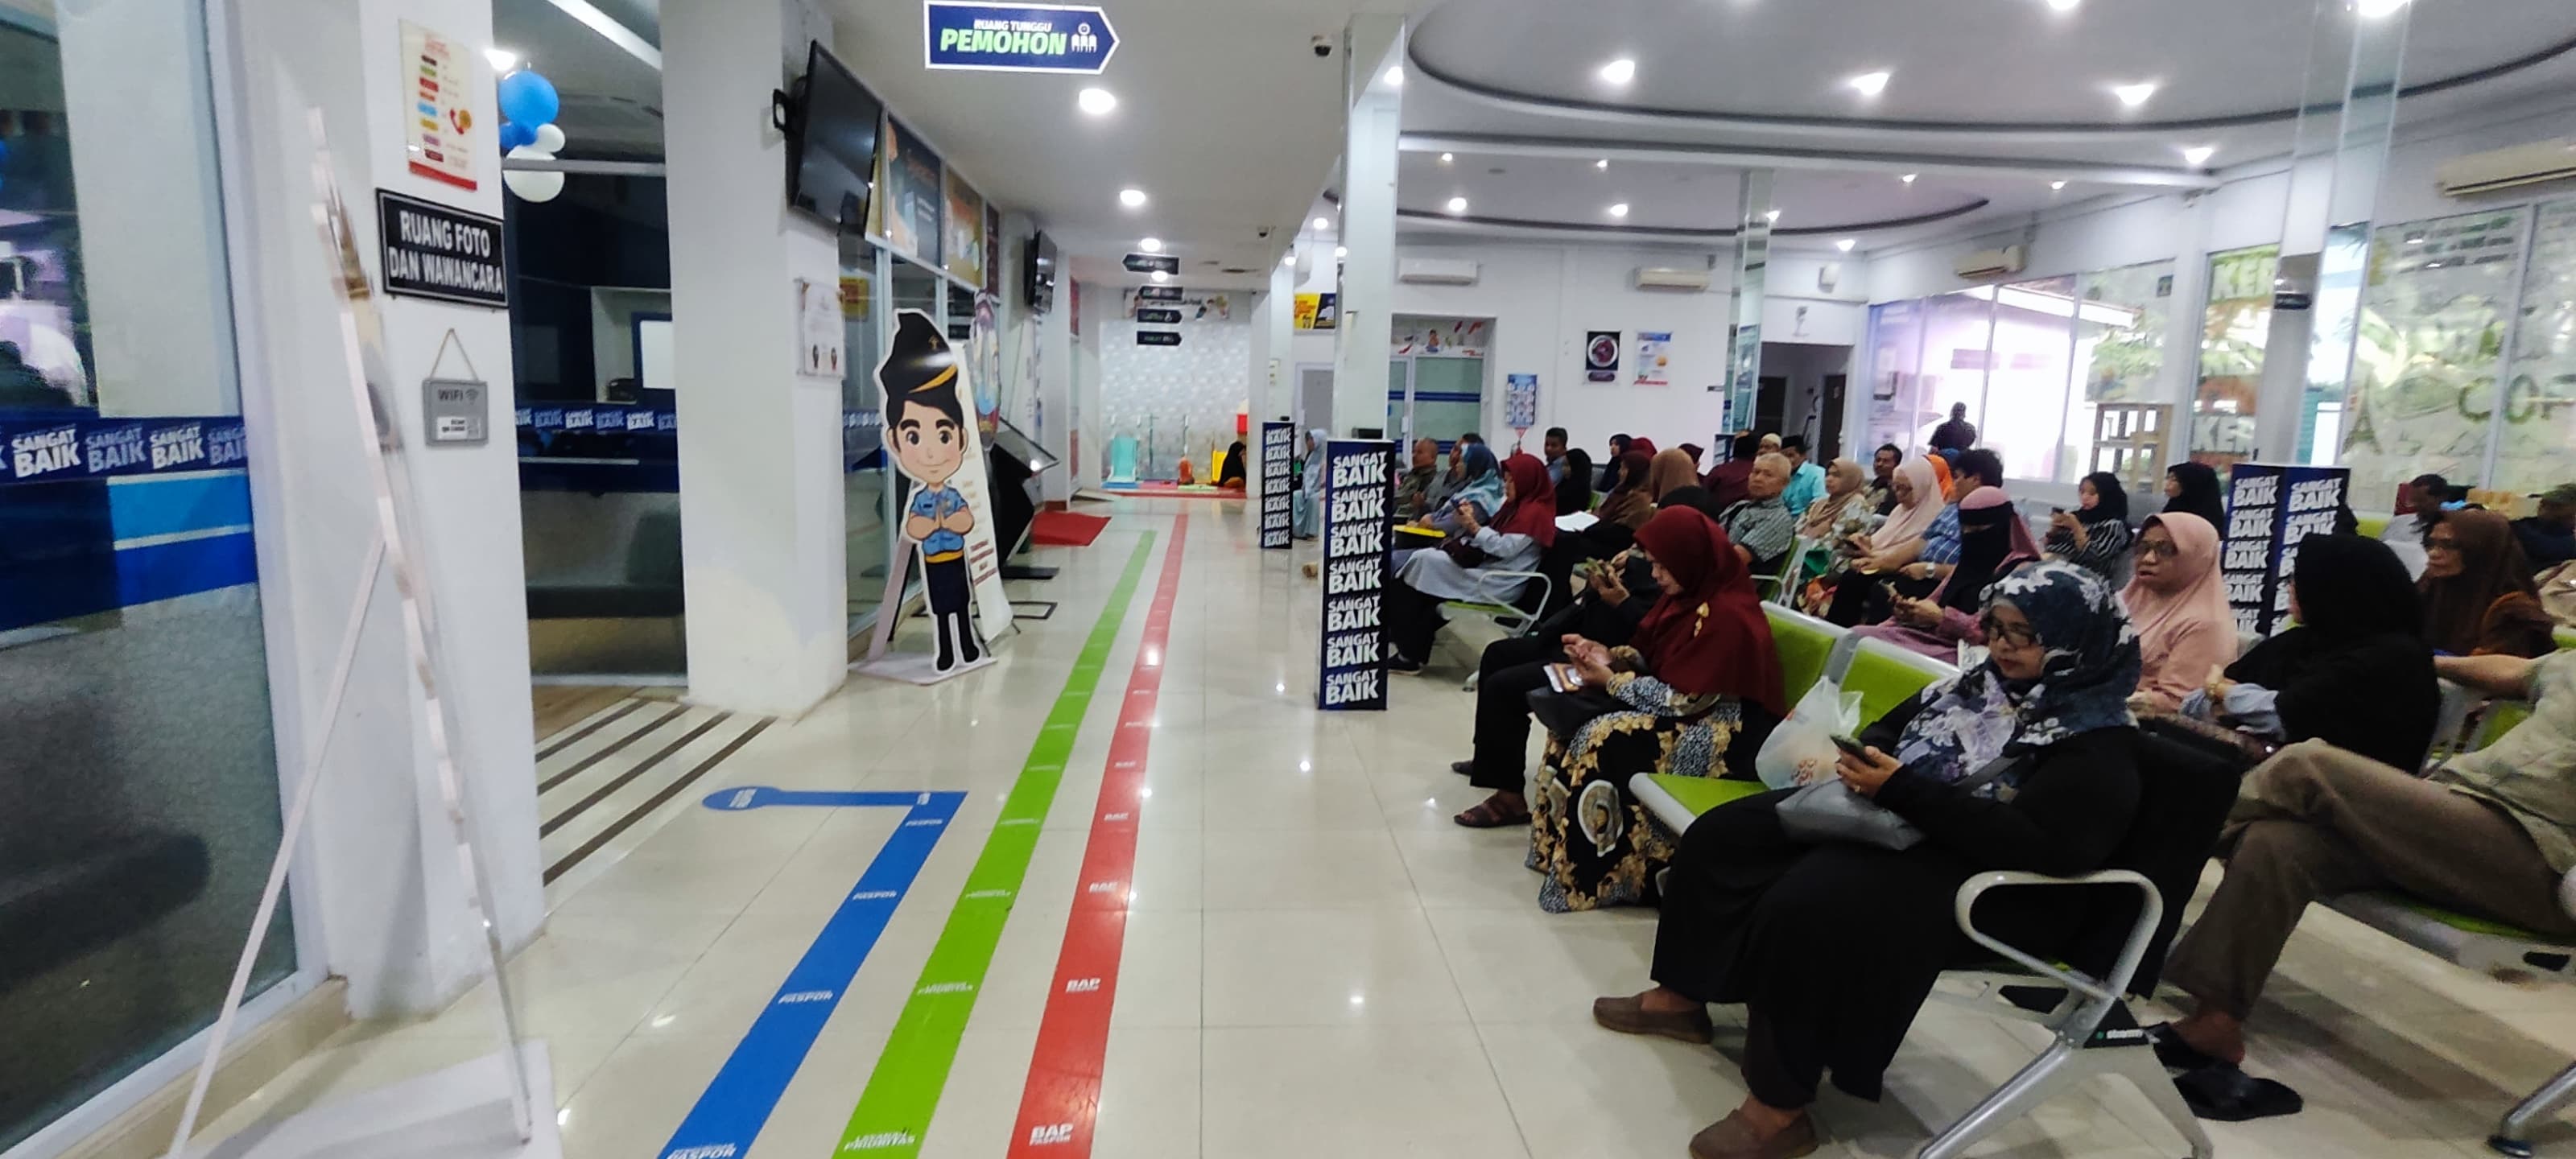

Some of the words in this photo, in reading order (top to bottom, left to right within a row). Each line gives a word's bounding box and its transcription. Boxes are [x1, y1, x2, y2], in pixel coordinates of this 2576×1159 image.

[973, 19, 1009, 31] RUANG
[1010, 21, 1052, 32] TUNGGU
[940, 28, 1067, 55] PEMOHON
[399, 210, 452, 250] RUANG
[455, 223, 490, 258] FOTO
[388, 246, 420, 281] DAN
[422, 254, 503, 294] WAWANCARA
[11, 428, 76, 453] SANGAT
[85, 427, 142, 452] SANGAT
[149, 426, 201, 447] SANGAT
[14, 441, 81, 478] BAIK
[88, 439, 147, 473] BAIK
[151, 437, 205, 469] BAIK
[1333, 451, 1387, 469] SANGAT
[1332, 463, 1387, 489] BAIK
[2235, 475, 2280, 488] SANGAT
[2291, 477, 2343, 494] SANGAT
[1331, 486, 1385, 504] SANGAT
[2232, 486, 2278, 507] BAIK
[2288, 488, 2341, 512] BAIK
[1331, 497, 1385, 523] BAIK
[2231, 508, 2276, 521] SANGAT
[2285, 510, 2337, 525] SANGAT
[1330, 521, 1384, 538] SANGAT
[2228, 518, 2273, 538] BAIK
[1329, 532, 1384, 558] BAIK
[2227, 540, 2271, 552] SANGAT
[1328, 558, 1381, 575] SANGAT
[2224, 550, 2268, 570] BAIK
[1328, 568, 1382, 595] BAIK
[1328, 595, 1381, 613] SANGAT
[1327, 606, 1381, 632] BAIK
[1327, 632, 1380, 649] SANGAT
[1327, 642, 1380, 669] BAIK
[1326, 669, 1378, 686] SANGAT
[1326, 679, 1378, 705] BAIK
[1089, 882, 1117, 891] BAP
[1067, 978, 1101, 990] BAP
[1031, 1123, 1074, 1140] BAP
